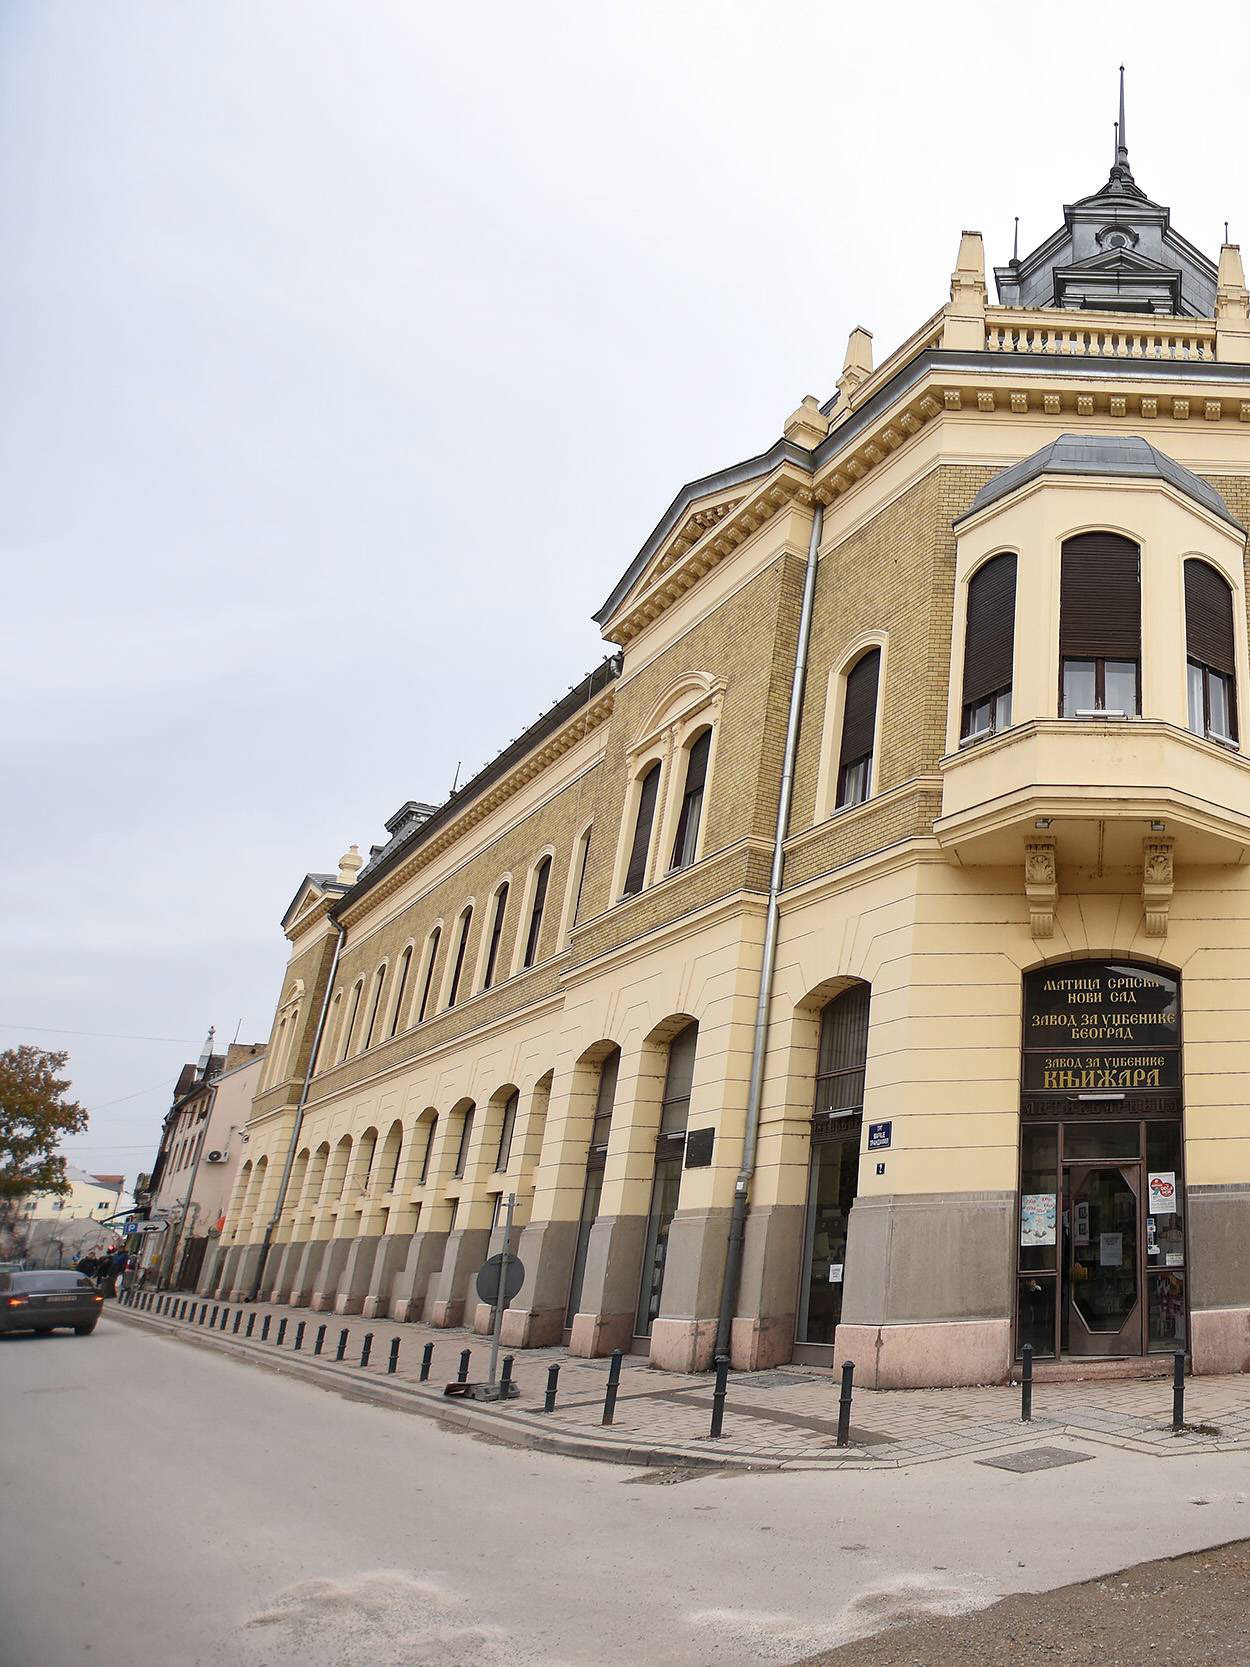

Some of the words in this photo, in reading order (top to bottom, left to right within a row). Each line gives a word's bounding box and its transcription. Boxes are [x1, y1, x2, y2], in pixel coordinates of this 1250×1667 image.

[1043, 978, 1100, 991] МАТИЦА
[1067, 992, 1102, 1004] НОВИ
[1110, 991, 1137, 1003] САД
[1031, 1014, 1077, 1027] ЗАВОД
[1080, 1013, 1098, 1026] ЗА
[1101, 1013, 1176, 1028] УЏБЕНИКЕ
[1071, 1027, 1134, 1040] БЕОГРАД
[1045, 1058, 1083, 1069] ЗАВОД
[1085, 1057, 1100, 1068] ЗА
[1103, 1056, 1165, 1069] УЏБЕНИКЕ
[1043, 1068, 1160, 1089] КЊИЖАРА
